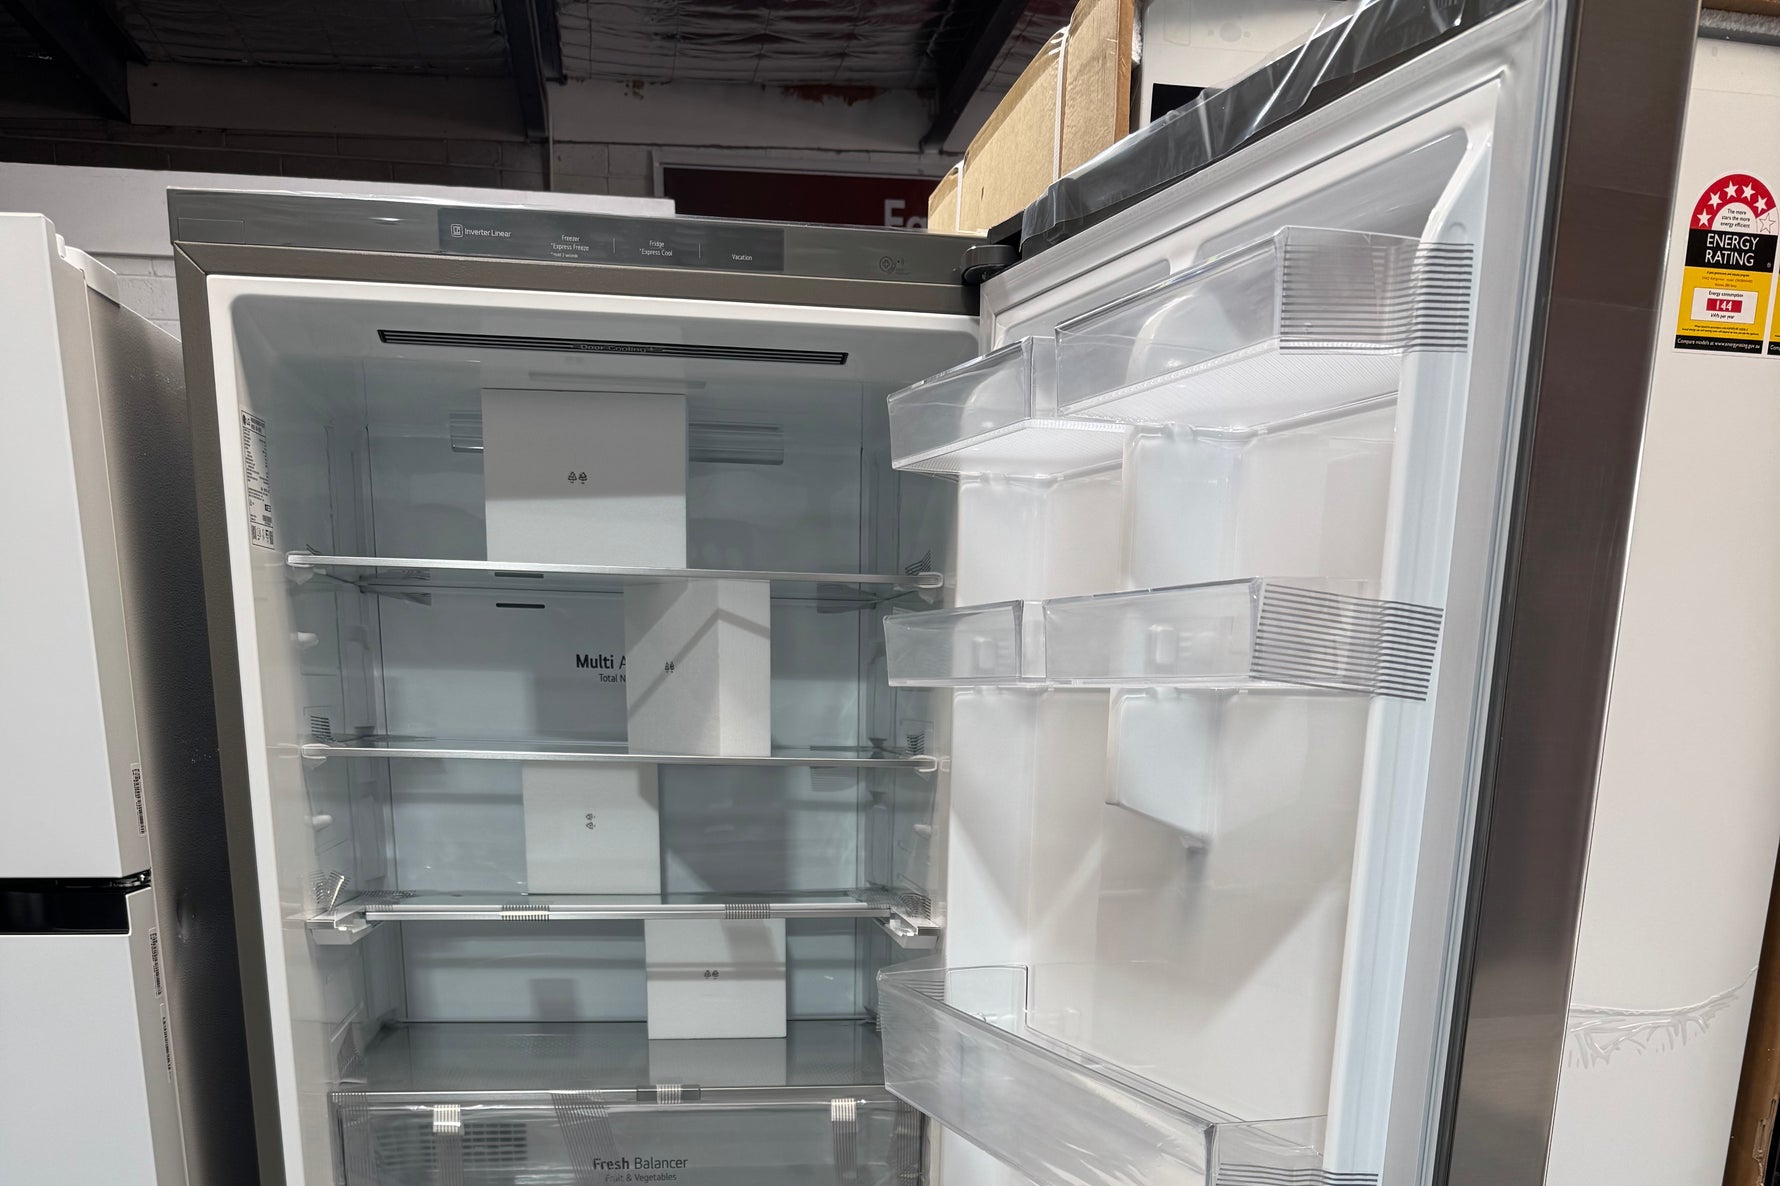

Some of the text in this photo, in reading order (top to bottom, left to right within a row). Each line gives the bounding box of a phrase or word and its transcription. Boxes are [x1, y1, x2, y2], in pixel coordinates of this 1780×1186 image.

[464, 227, 512, 238] Inverter Linear
[561, 234, 580, 242] Freezer
[1707, 233, 1759, 250] ENERGY
[572, 244, 590, 252] Freeze
[649, 240, 665, 249] Fridge
[661, 249, 673, 257] Cool
[732, 253, 753, 261] Vacation
[1705, 250, 1754, 266] RATING
[1716, 300, 1732, 310] 144
[576, 654, 614, 669] Multi
[599, 674, 618, 683] Total
[593, 1157, 688, 1170] Fresh Balancer
[625, 1174, 632, 1182] &
[634, 1172, 677, 1184] Vegetables
